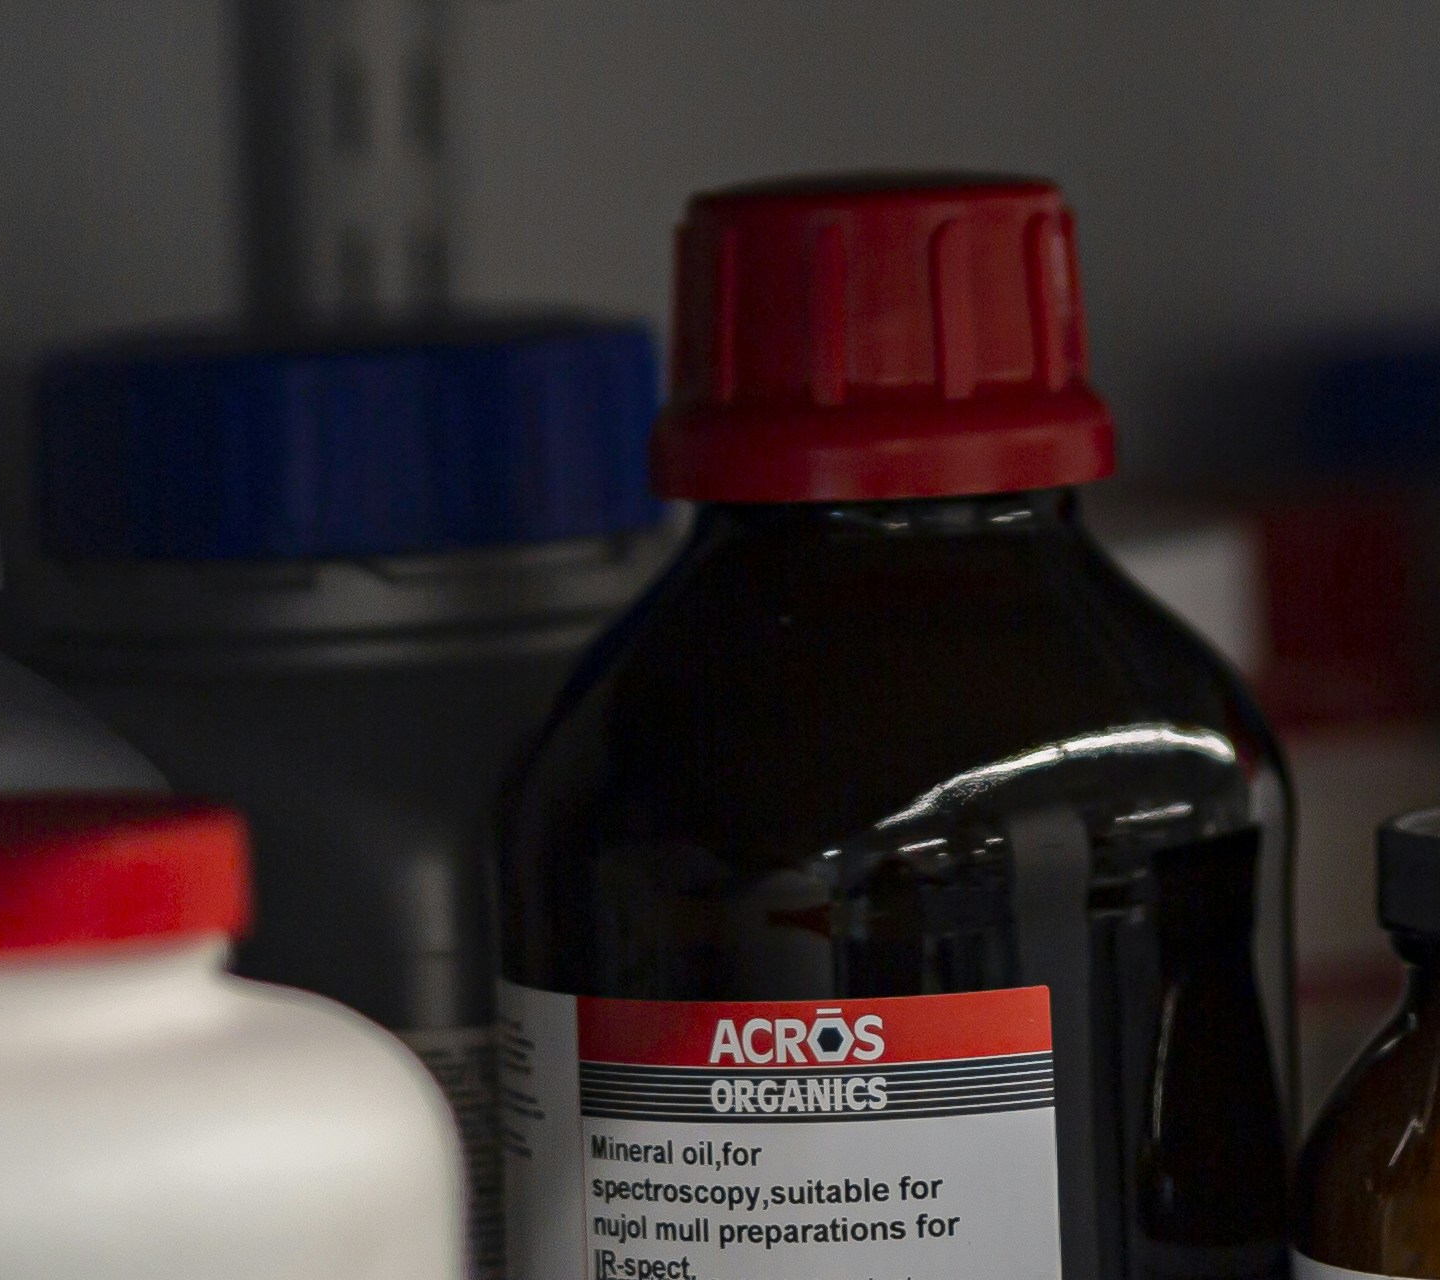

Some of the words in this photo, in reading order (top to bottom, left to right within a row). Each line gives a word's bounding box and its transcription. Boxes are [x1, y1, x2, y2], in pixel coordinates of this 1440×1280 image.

[710, 1076, 888, 1114] ORGANICS
[591, 1135, 674, 1165] Mineral
[898, 1176, 944, 1201] for
[594, 1215, 647, 1244] nujol
[655, 1217, 709, 1242] mull
[719, 1217, 907, 1250] preparations
[916, 1214, 960, 1238] for
